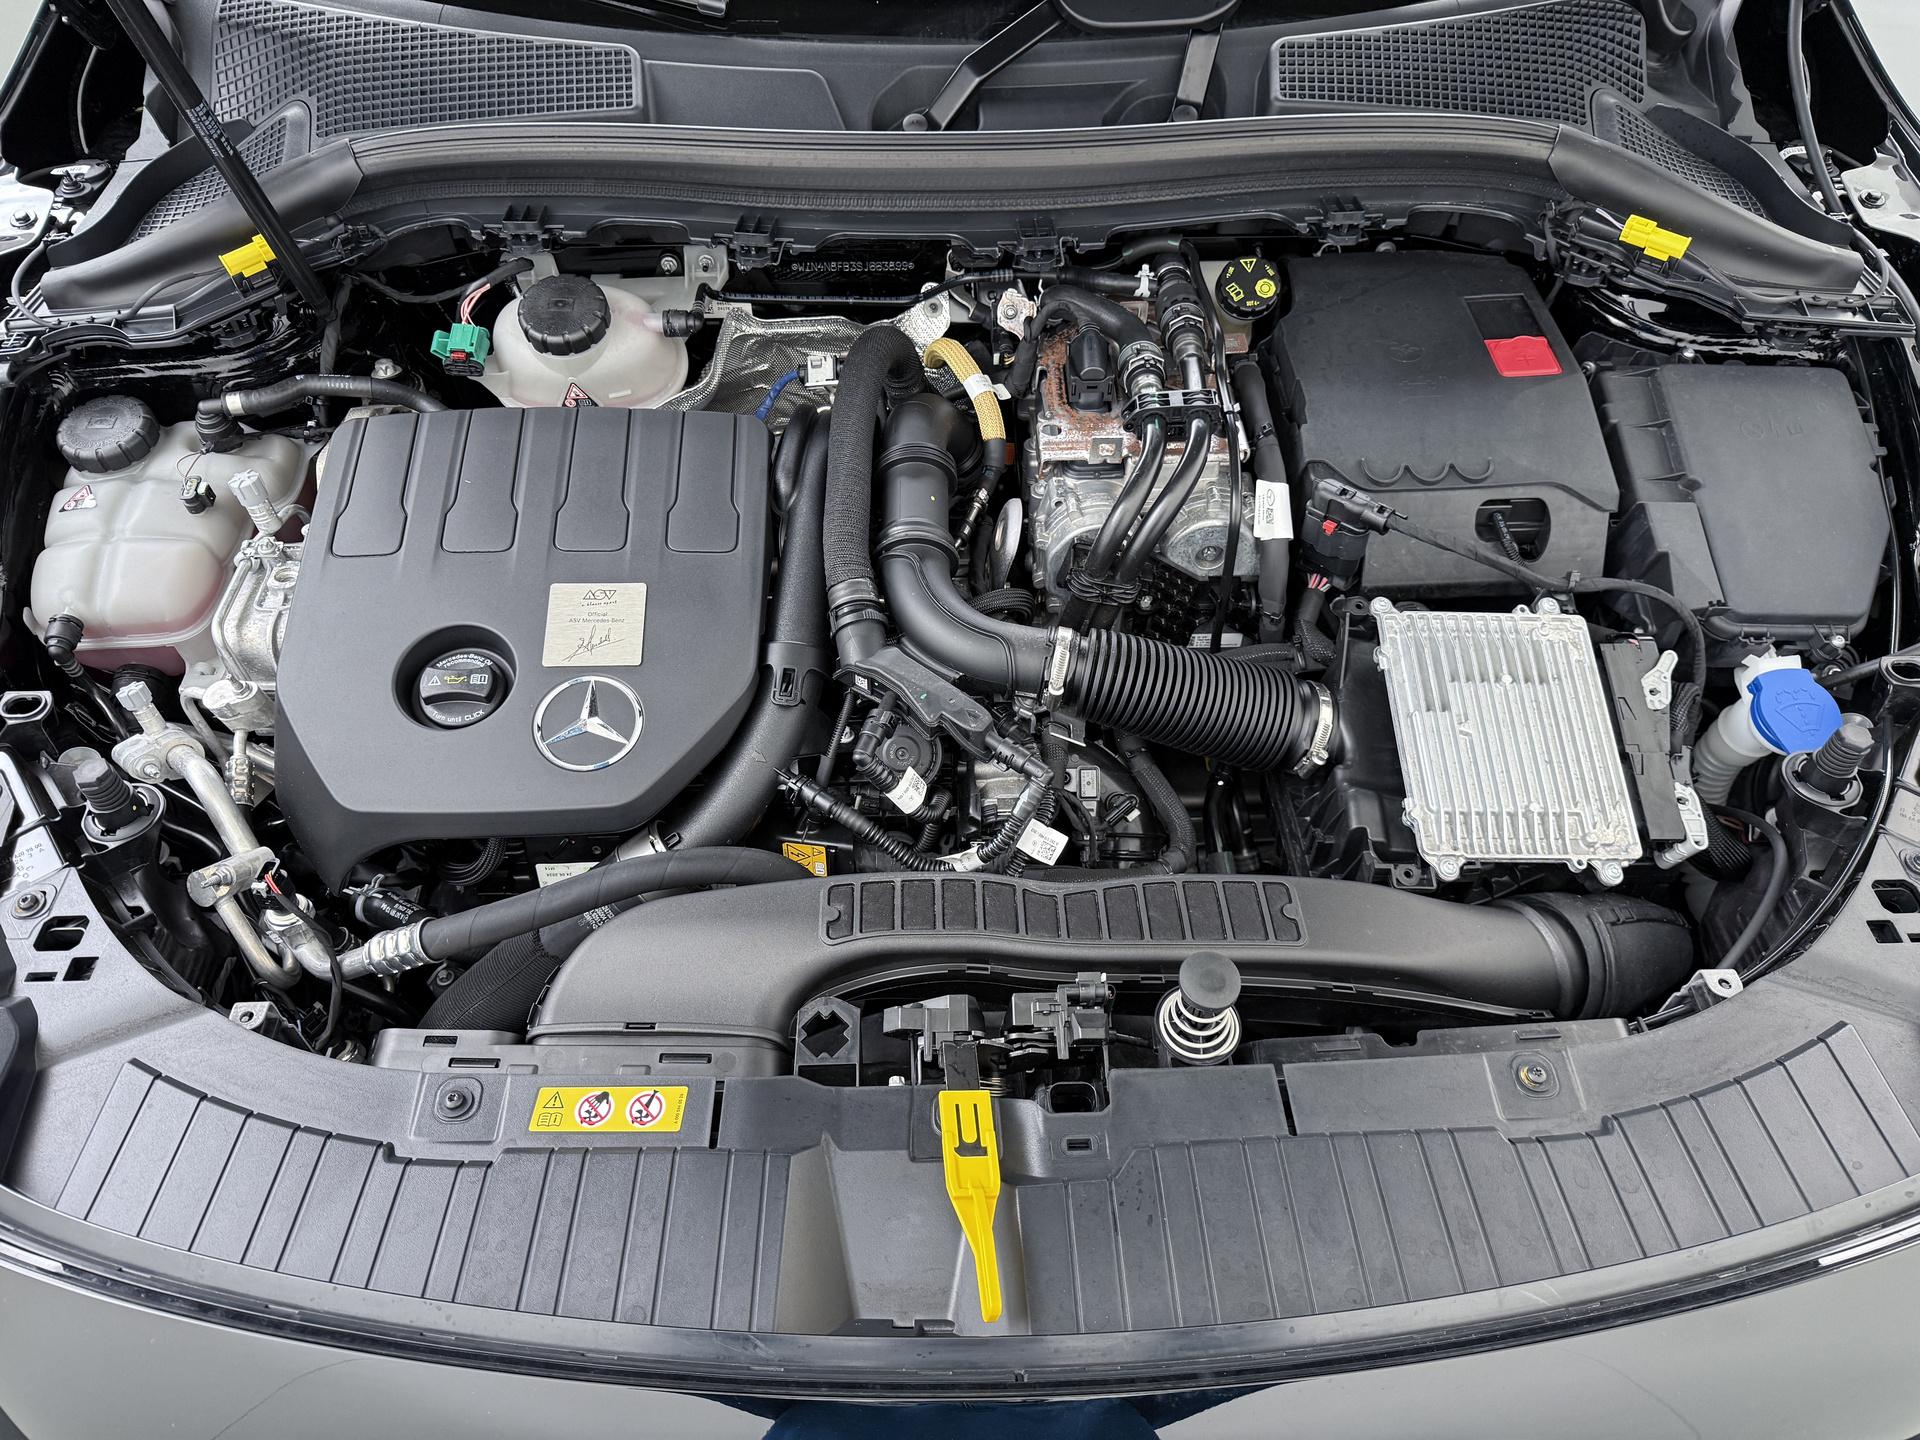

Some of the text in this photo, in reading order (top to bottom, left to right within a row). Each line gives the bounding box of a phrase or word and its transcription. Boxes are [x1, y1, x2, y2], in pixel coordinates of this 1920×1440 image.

[443, 658, 486, 669] recommended
[432, 710, 446, 721] Turn
[464, 710, 485, 721] CLICK
